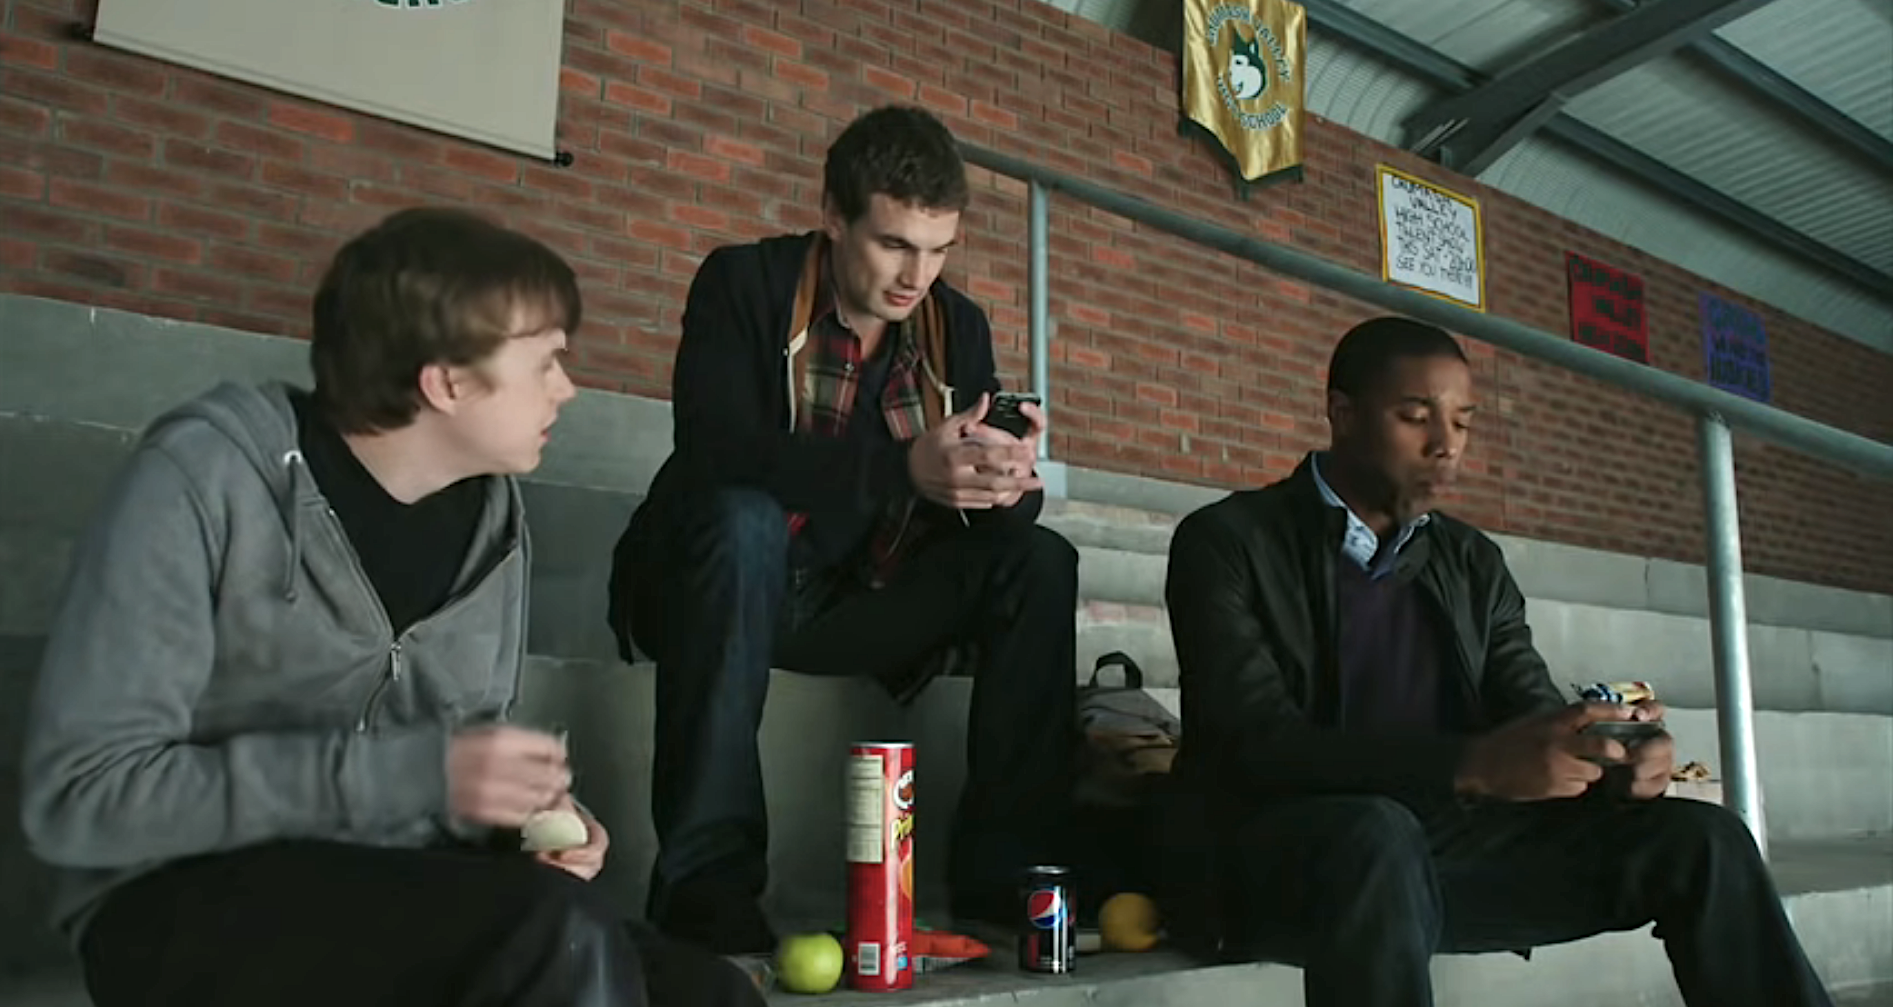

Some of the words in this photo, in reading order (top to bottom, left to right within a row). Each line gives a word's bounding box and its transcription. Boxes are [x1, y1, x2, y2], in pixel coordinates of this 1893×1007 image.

[1240, 101, 1289, 131] SCHOOL
[1409, 196, 1458, 220] VALLEY
[1395, 205, 1424, 226] HIGH
[1427, 213, 1471, 244] SCHOOL
[1396, 254, 1415, 271] SEE
[1419, 261, 1437, 277] YOU
